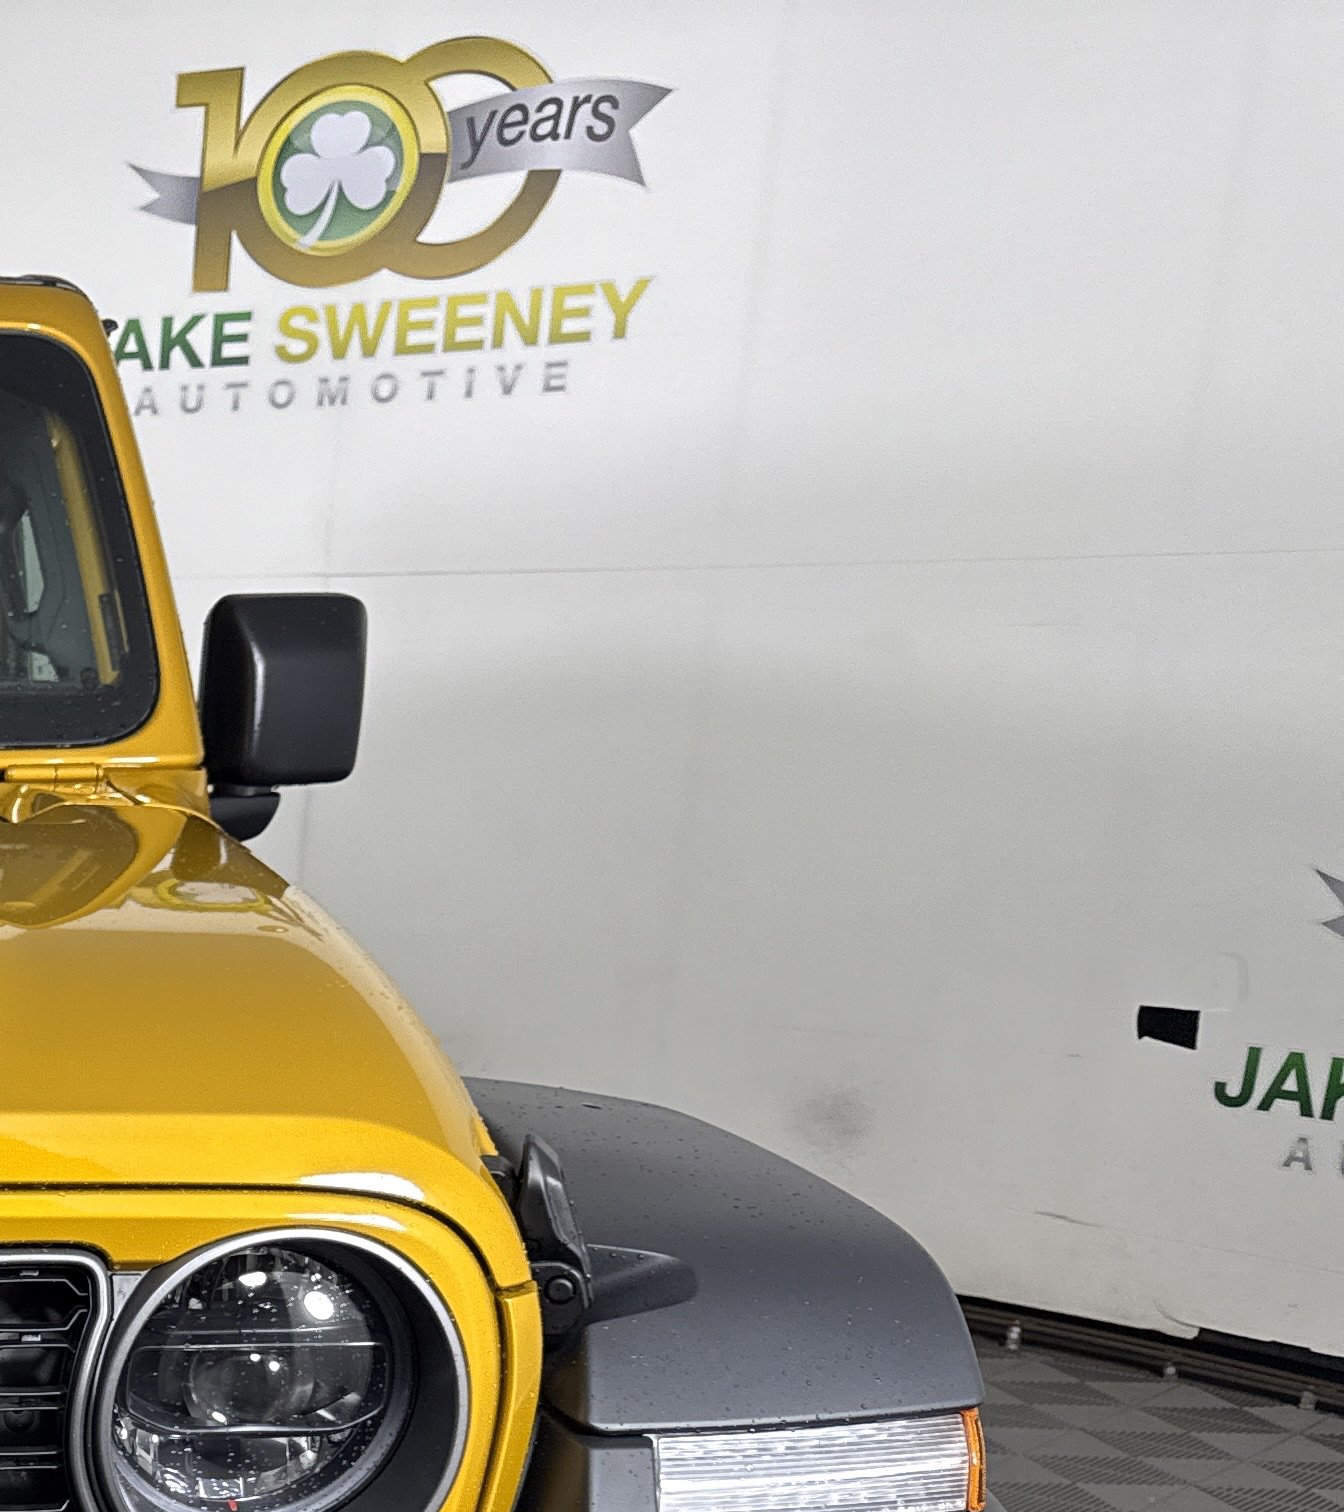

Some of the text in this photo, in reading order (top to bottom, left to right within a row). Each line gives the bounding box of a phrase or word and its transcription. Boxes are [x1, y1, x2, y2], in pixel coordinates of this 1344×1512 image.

[460, 93, 621, 169] years
[113, 275, 653, 372] AKE SWEENEY
[134, 361, 569, 418] AUTOMOTIVE
